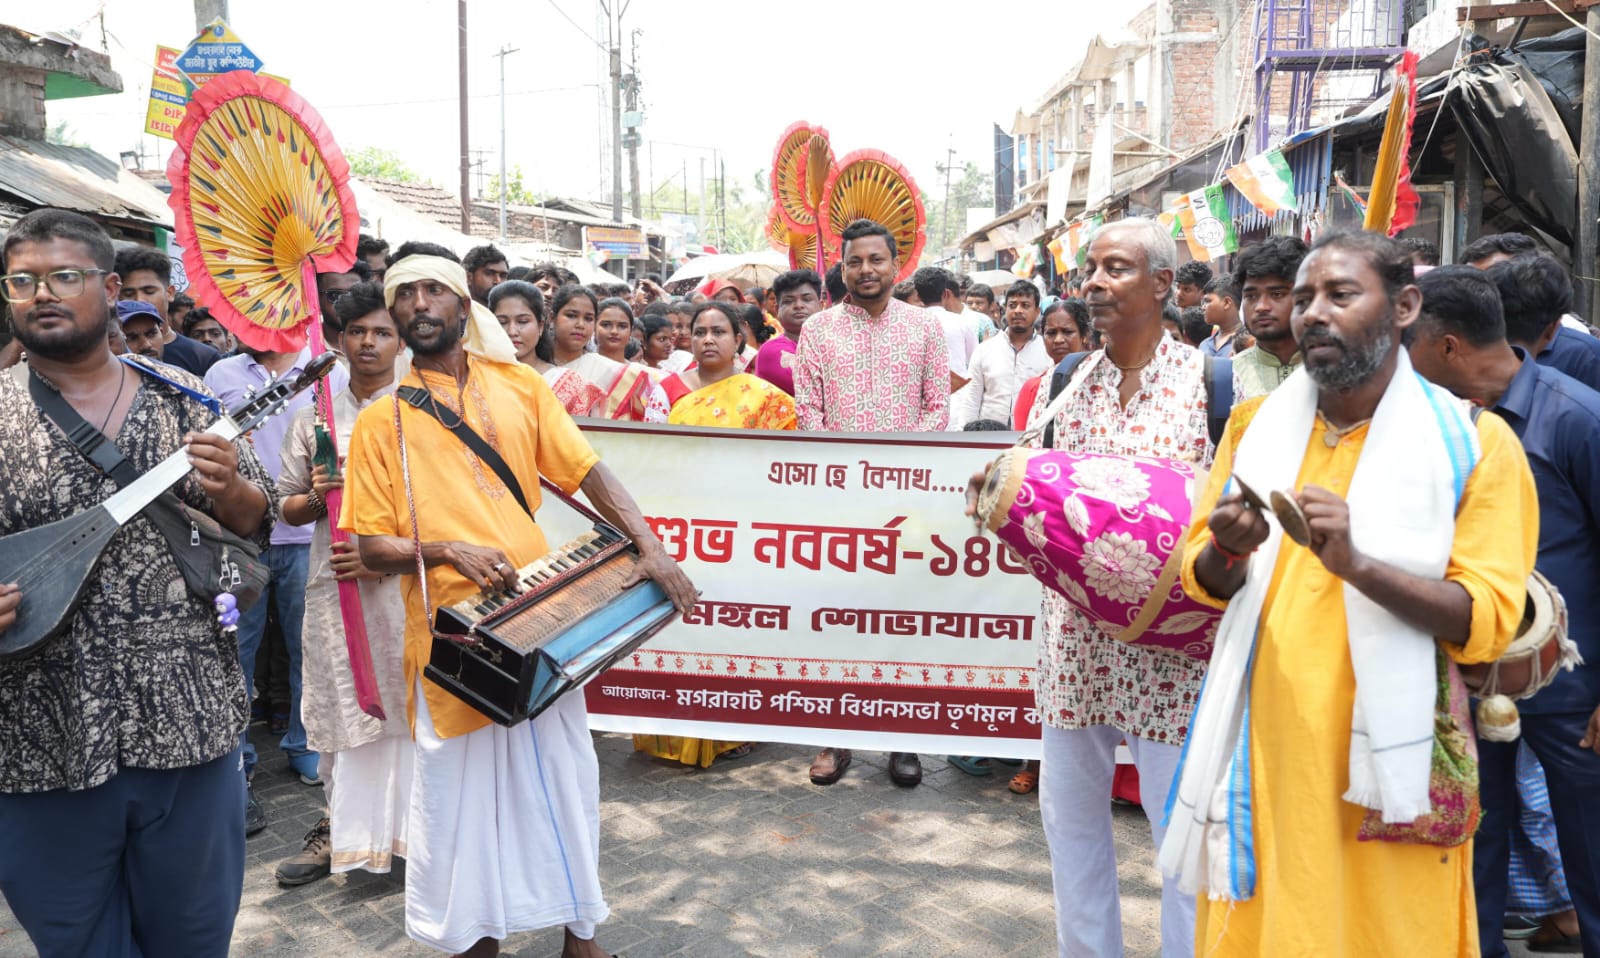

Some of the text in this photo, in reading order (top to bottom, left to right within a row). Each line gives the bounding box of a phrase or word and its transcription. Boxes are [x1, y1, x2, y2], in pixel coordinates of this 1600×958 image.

[767, 461, 818, 486] এসো
[825, 464, 849, 490] হে
[811, 606, 1036, 641] শোভাযাত্রা
[676, 688, 764, 711] মগরাহাট
[769, 690, 835, 715] পশ্চিম
[839, 692, 941, 721] বিধানসভা
[946, 703, 1018, 732] তৃণমূল
